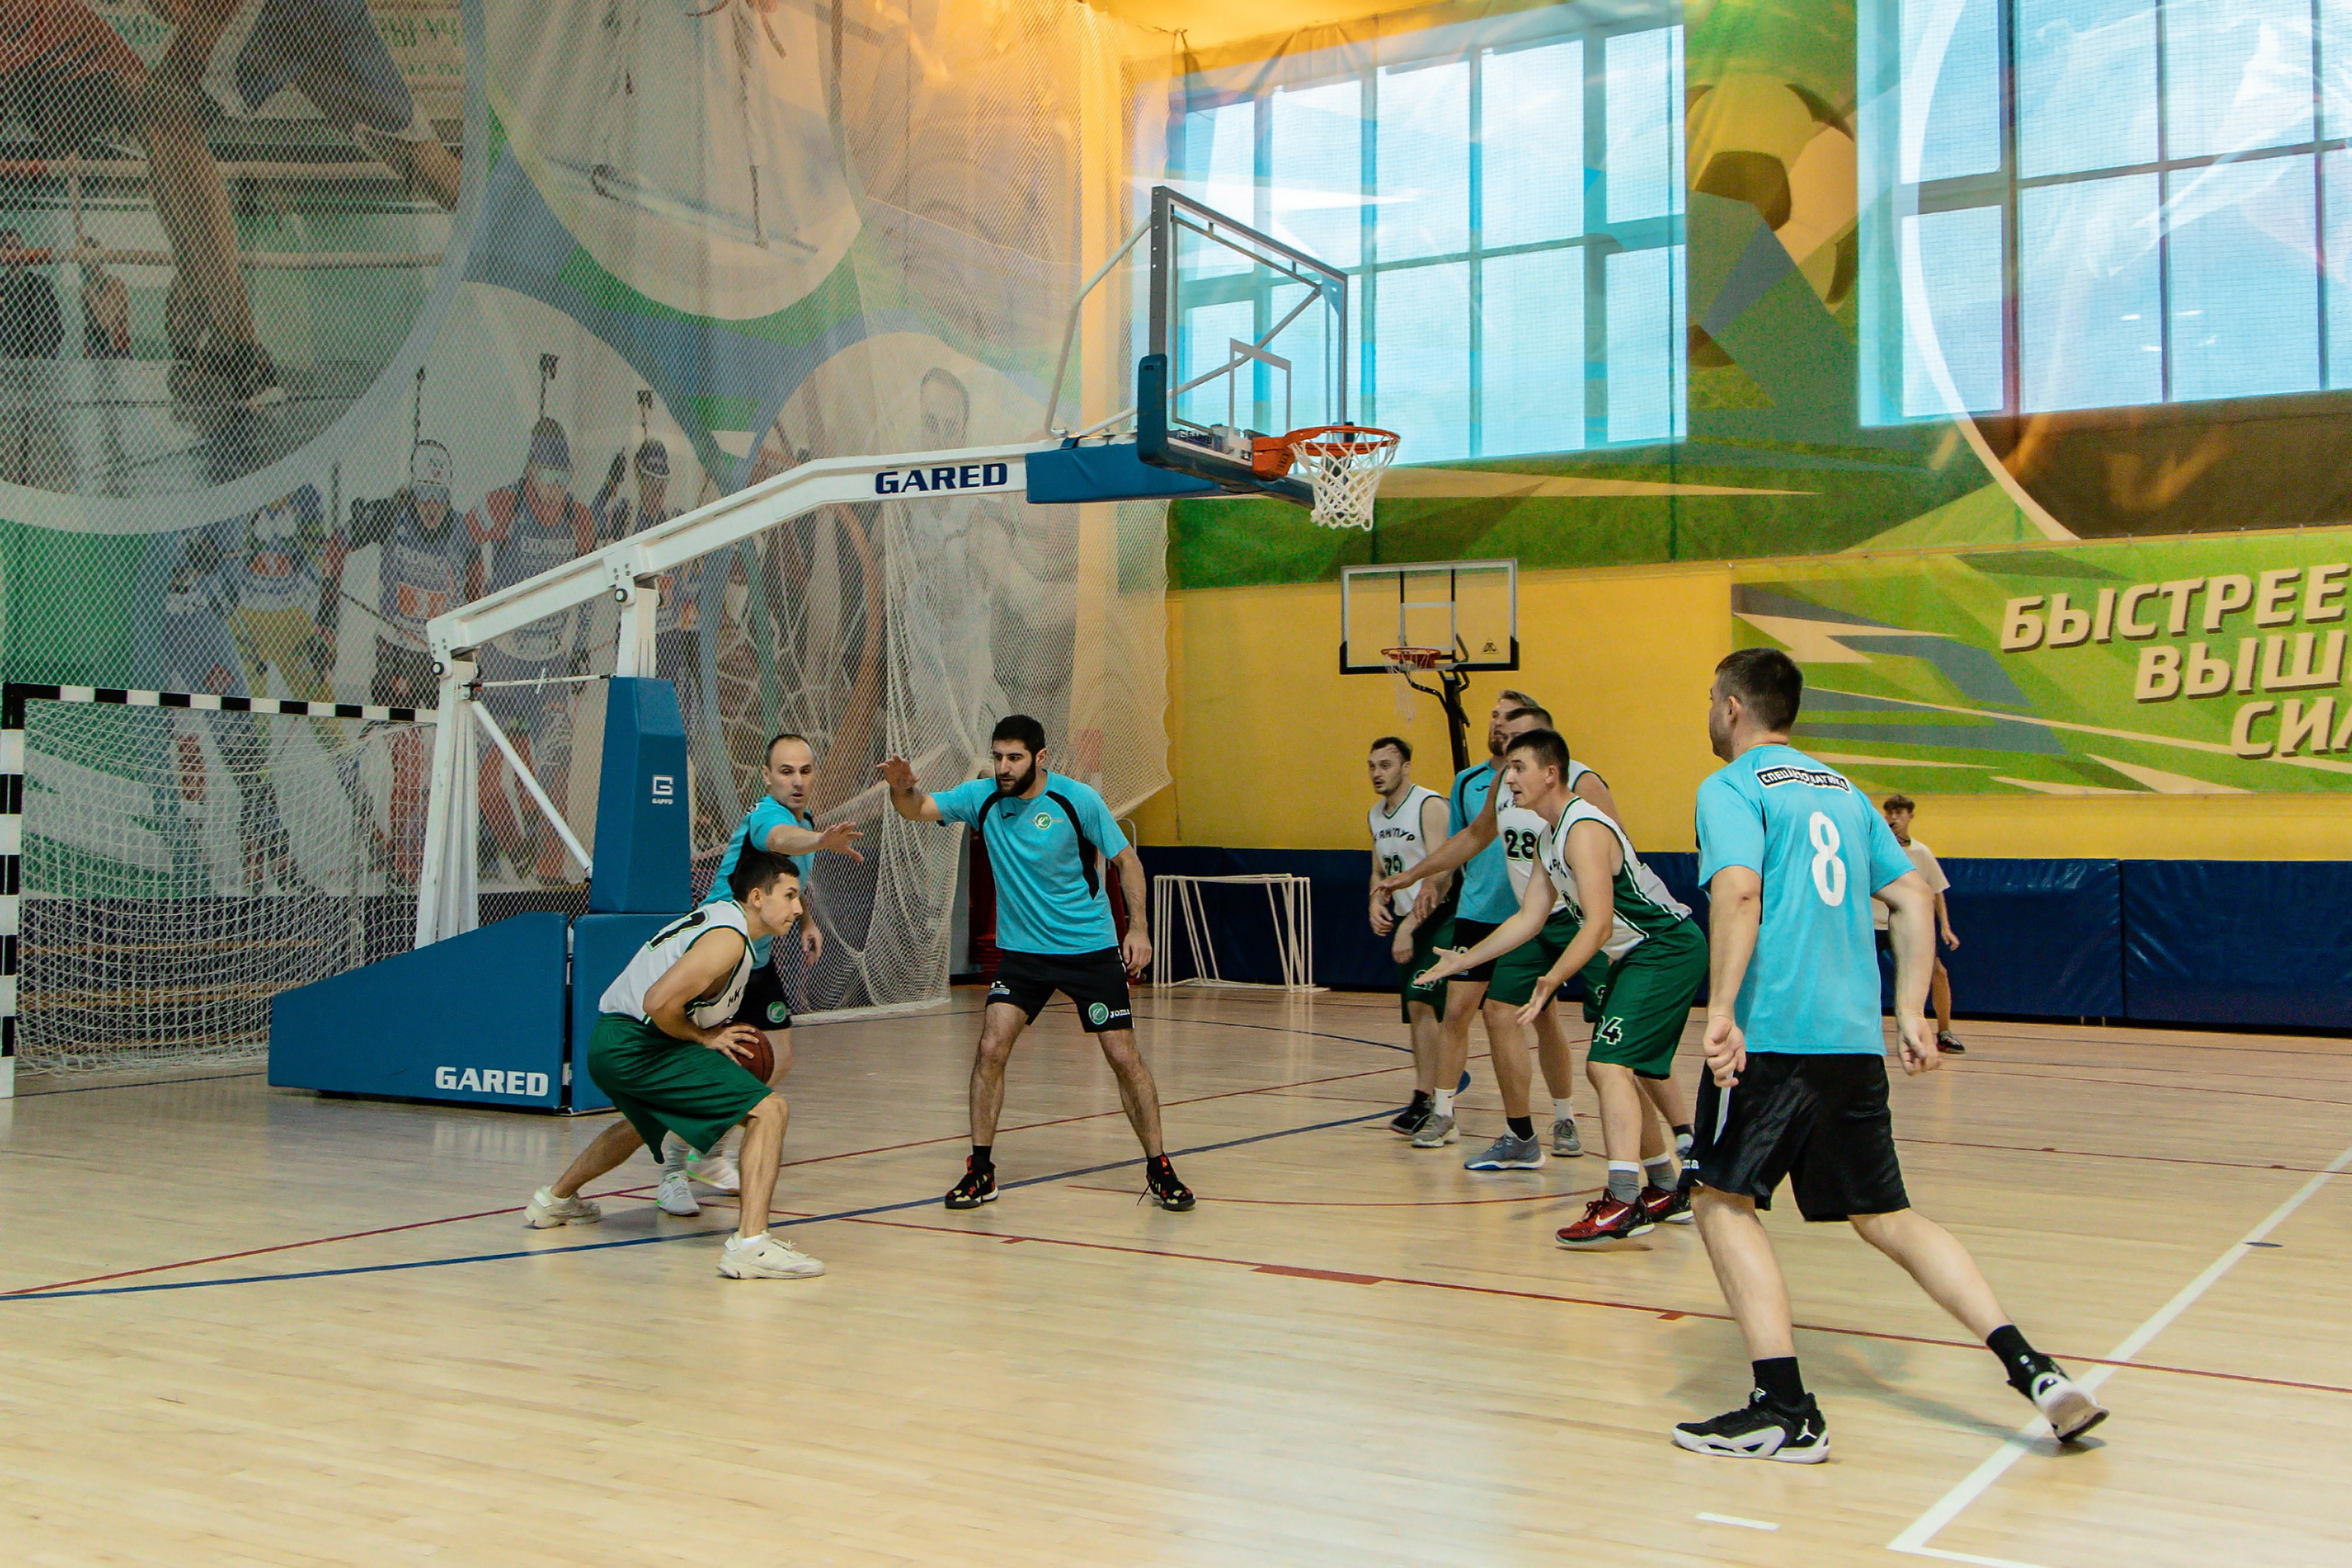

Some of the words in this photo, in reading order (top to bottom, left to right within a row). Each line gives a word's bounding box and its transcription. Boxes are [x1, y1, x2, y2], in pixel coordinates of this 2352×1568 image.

[876, 462, 1008, 495] GARED
[2000, 562, 2350, 653] БЫСТРЕЕ
[2134, 629, 2352, 704] ВЫШ
[1503, 827, 1537, 862] 28
[1809, 811, 1847, 908] 8
[435, 1066, 549, 1097] GARED
